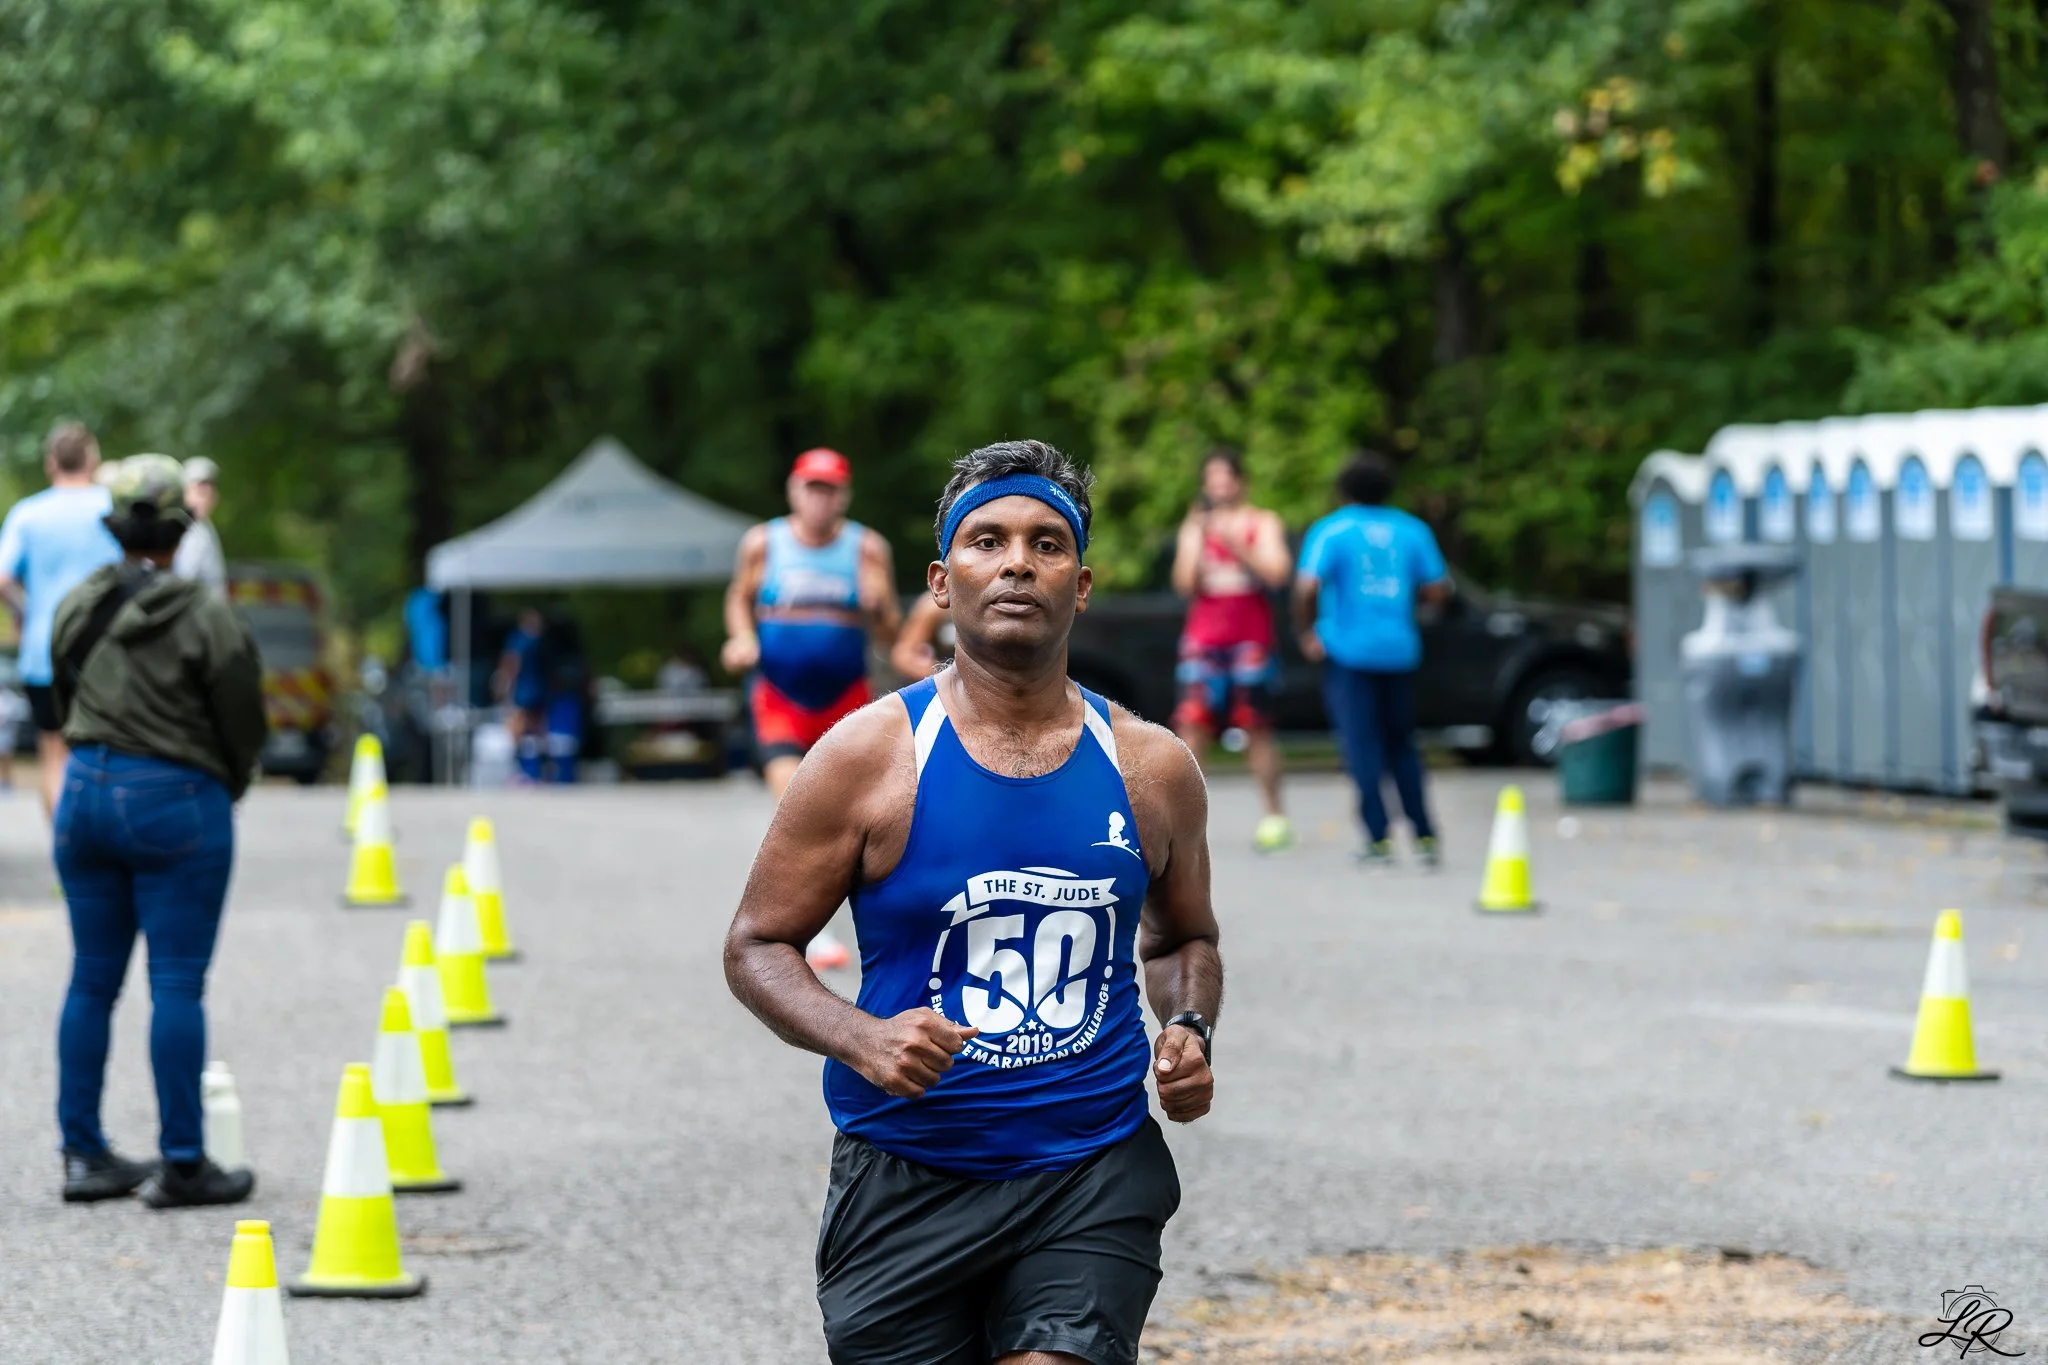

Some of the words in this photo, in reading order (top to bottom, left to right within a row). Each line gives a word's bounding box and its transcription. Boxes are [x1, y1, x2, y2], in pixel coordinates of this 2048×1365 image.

[983, 879, 1017, 894] THE
[1022, 881, 1046, 899] ST.
[1052, 886, 1101, 901] JUDE
[961, 910, 1097, 1034] 50
[1072, 982, 1110, 1054] CHALLENGE
[1005, 1032, 1054, 1055] 2019
